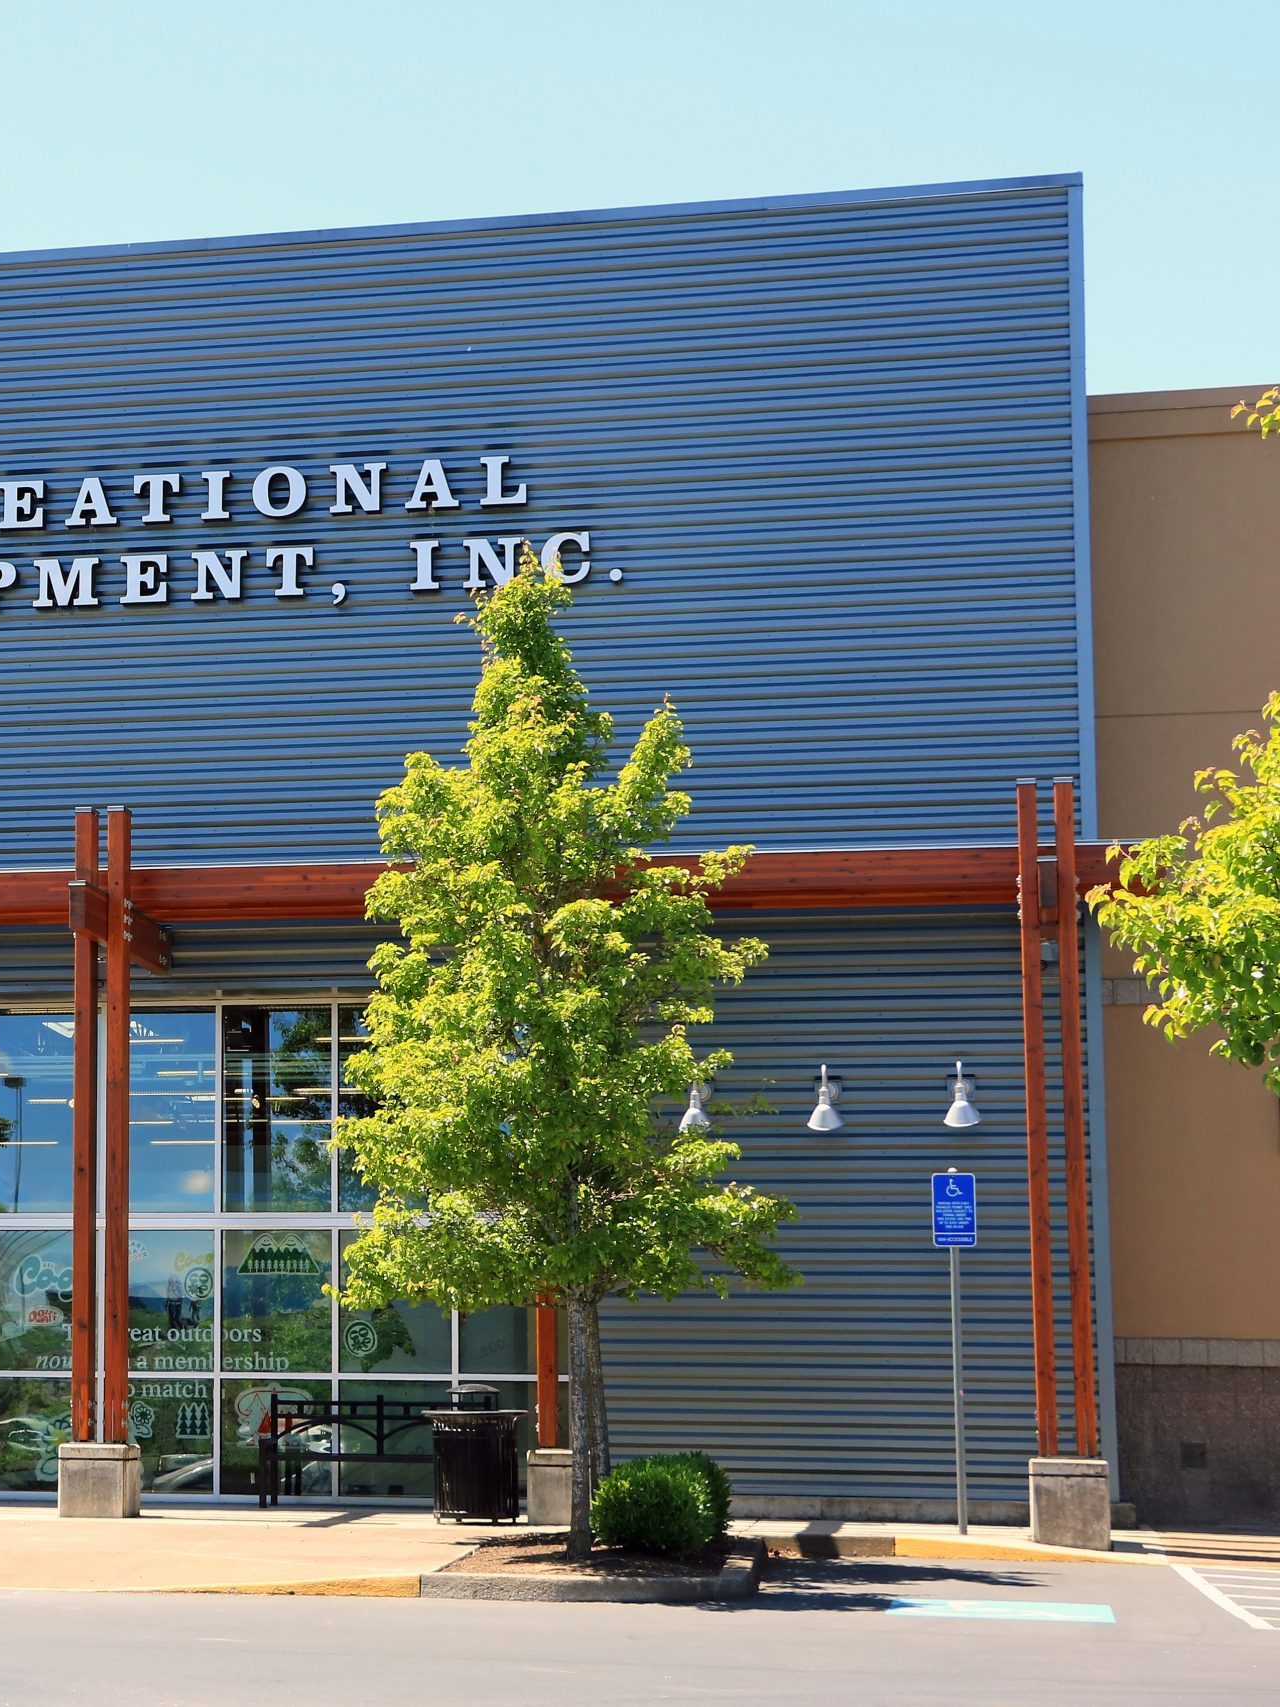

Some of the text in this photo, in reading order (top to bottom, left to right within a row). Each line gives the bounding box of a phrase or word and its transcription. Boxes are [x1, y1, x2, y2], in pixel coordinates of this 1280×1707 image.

[409, 531, 623, 591] INC.
[13, 1255, 73, 1302] Co-o
[128, 1327, 161, 1342] eat
[141, 1380, 208, 1398] match
